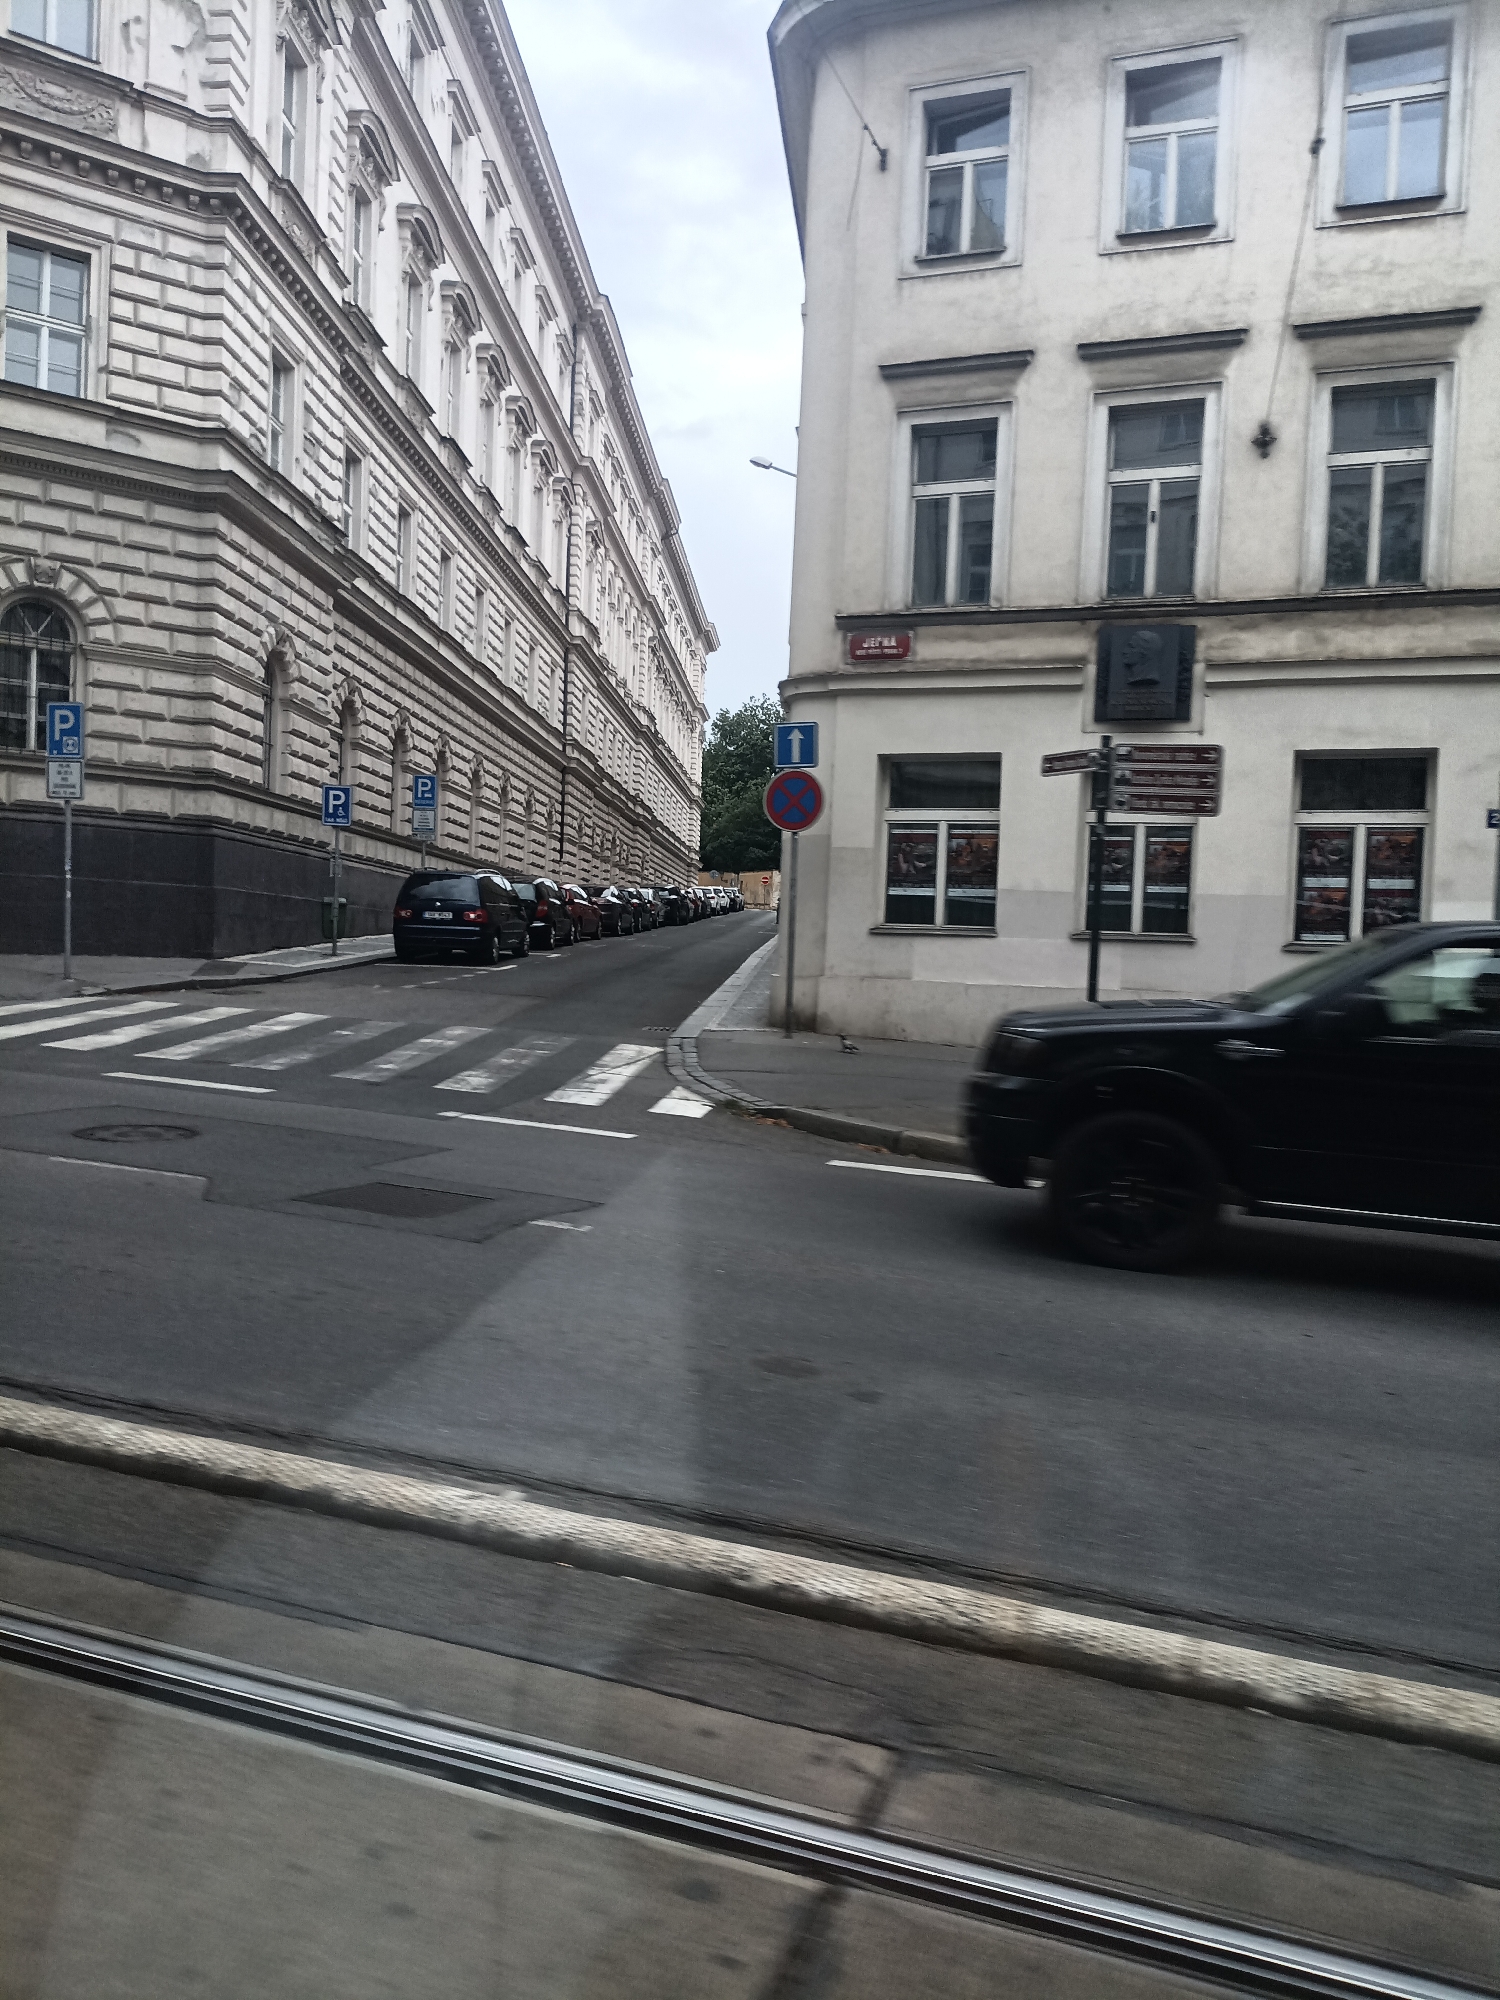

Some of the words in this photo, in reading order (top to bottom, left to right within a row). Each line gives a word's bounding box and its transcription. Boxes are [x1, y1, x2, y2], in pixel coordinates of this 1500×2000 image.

[54, 709, 75, 741] P
[418, 778, 432, 798] P
[328, 790, 346, 814] P
